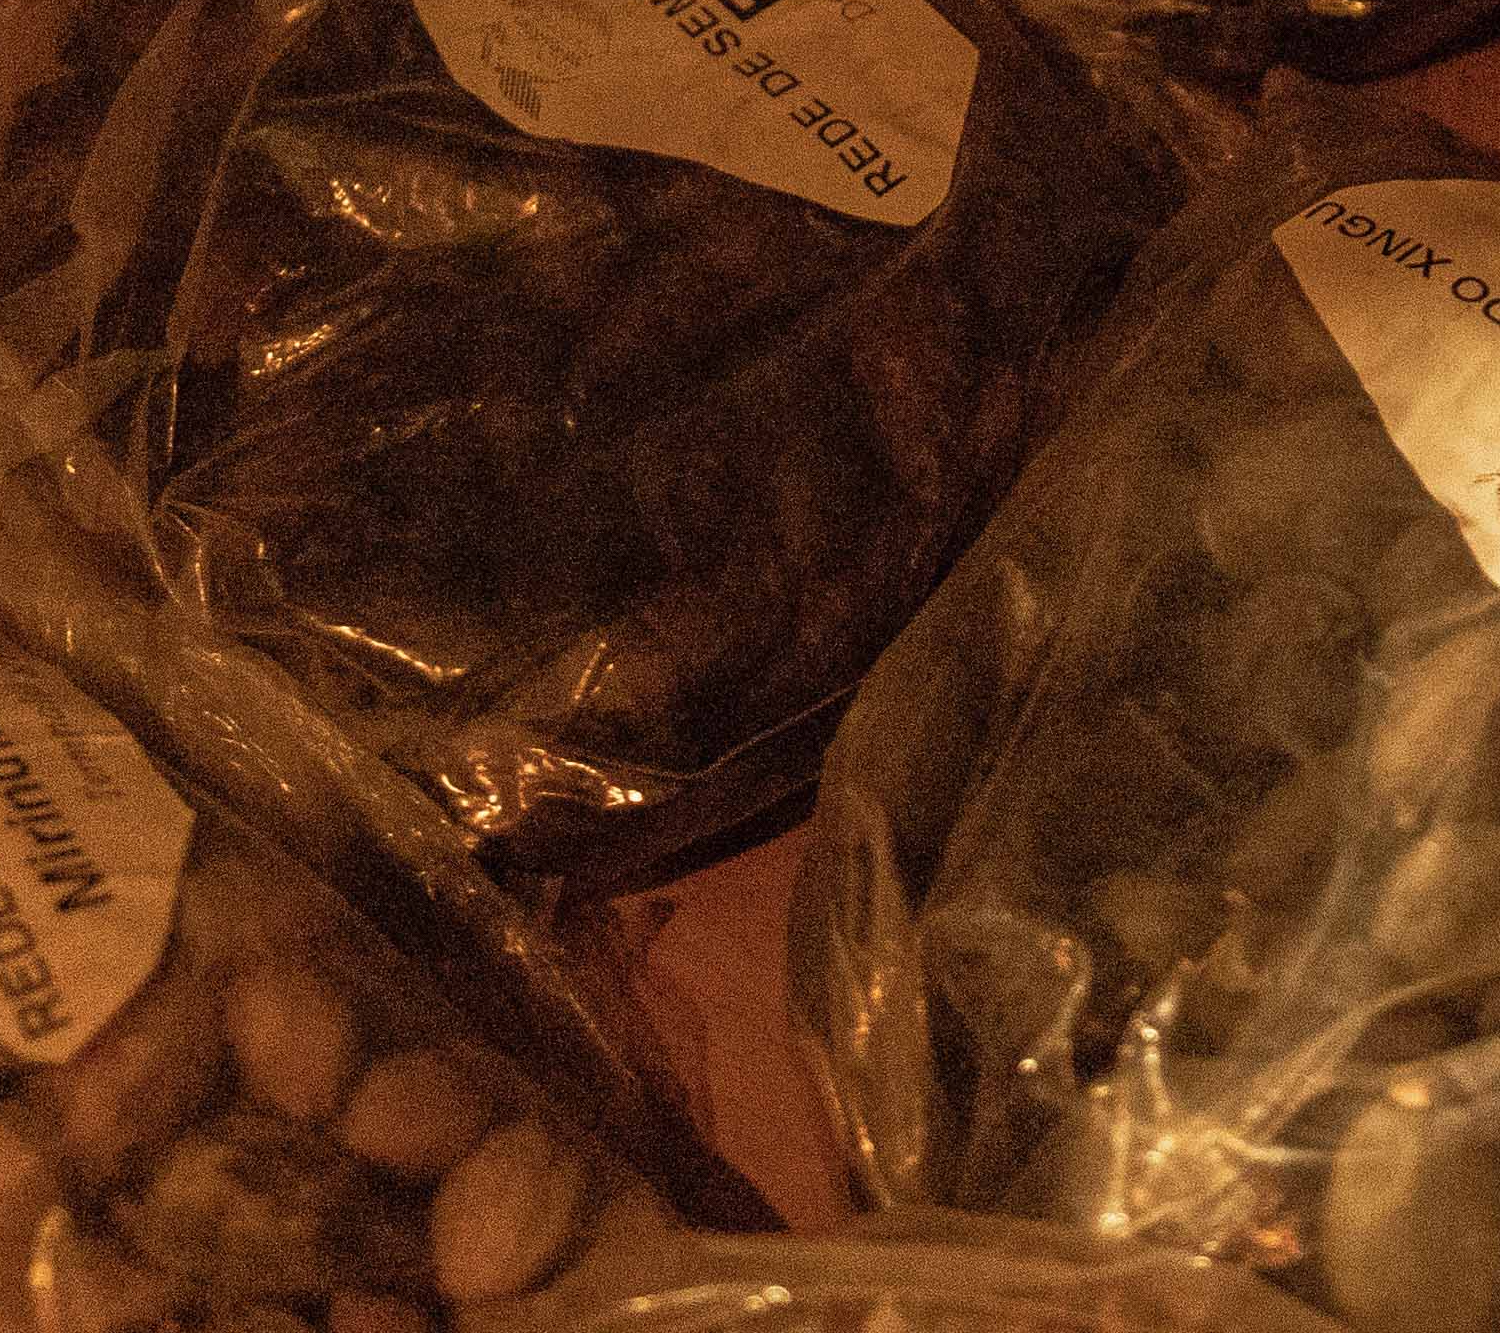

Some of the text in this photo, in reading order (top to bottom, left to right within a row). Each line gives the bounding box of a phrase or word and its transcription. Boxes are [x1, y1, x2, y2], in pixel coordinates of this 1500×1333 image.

[733, 52, 800, 99] DE
[790, 98, 907, 197] REDE
[1298, 191, 1451, 277] XINGU
